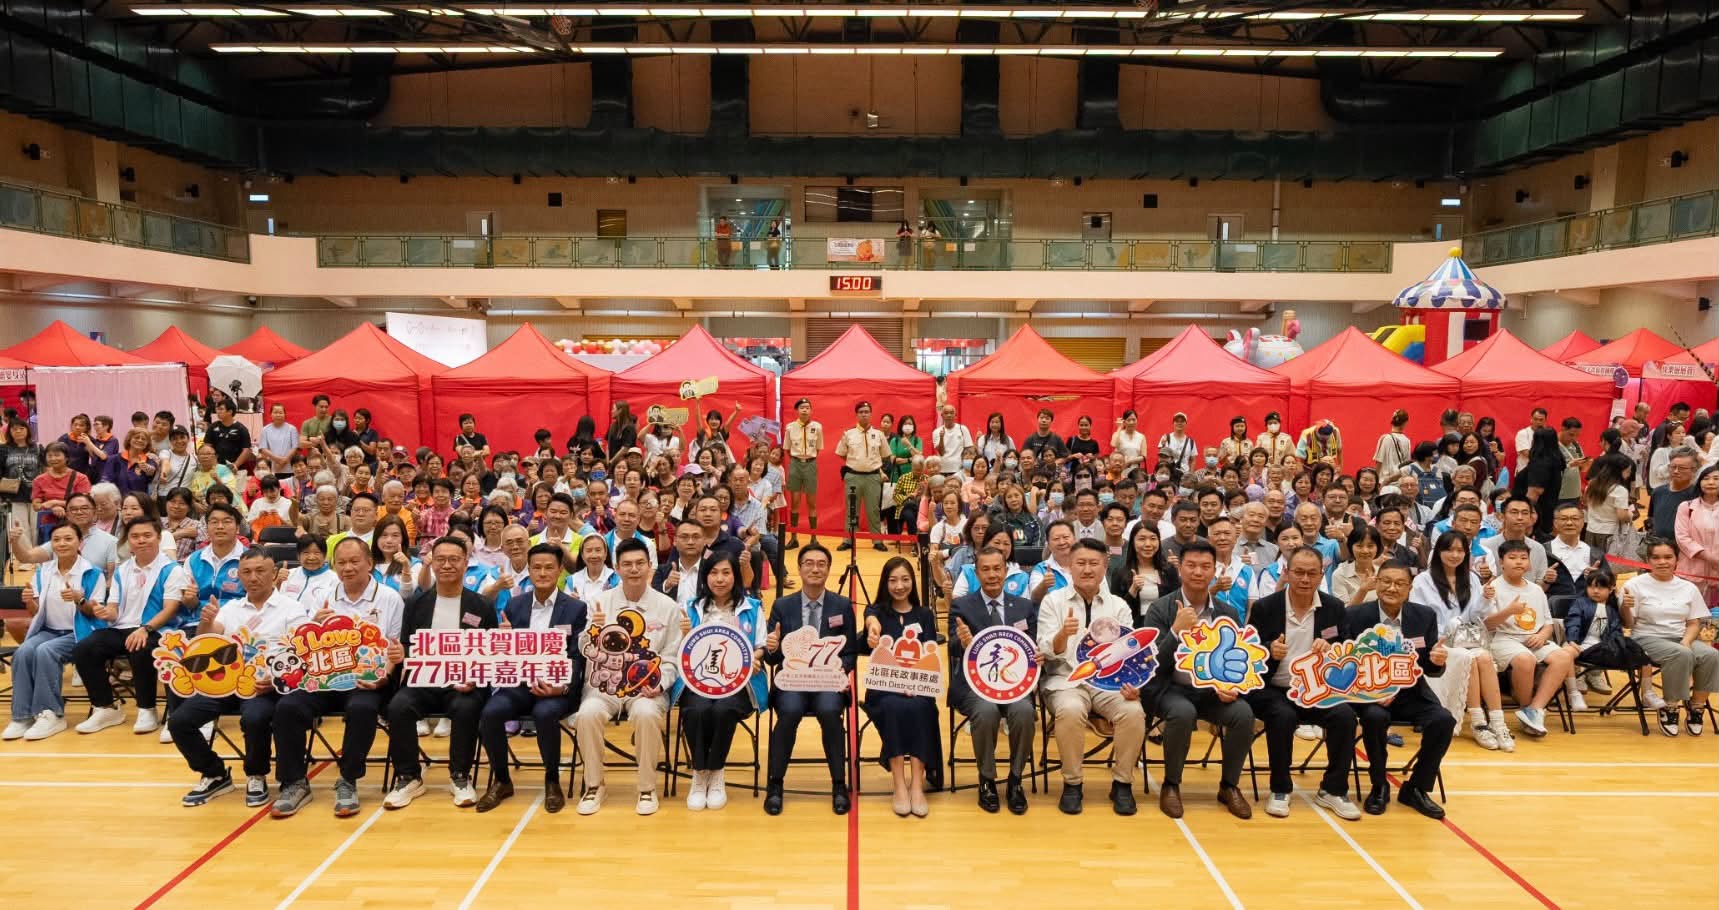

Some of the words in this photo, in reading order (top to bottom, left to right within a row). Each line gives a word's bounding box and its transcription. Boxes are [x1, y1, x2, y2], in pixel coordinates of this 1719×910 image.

[294, 635, 308, 655] I
[306, 628, 361, 651] Love
[411, 631, 564, 656] 北區共賀國慶
[715, 628, 730, 636] AREA
[730, 633, 749, 663] COMMITTEE
[998, 631, 1014, 639] AREA
[308, 646, 353, 673] 北區
[808, 638, 843, 668] 77
[406, 660, 570, 684] 77周年嘉年華
[869, 666, 939, 684] 北區民政事務處
[1294, 654, 1328, 702] I
[1359, 653, 1413, 689] 北區
[865, 677, 887, 687] North
[888, 680, 916, 691] District
[917, 684, 941, 694] Office
